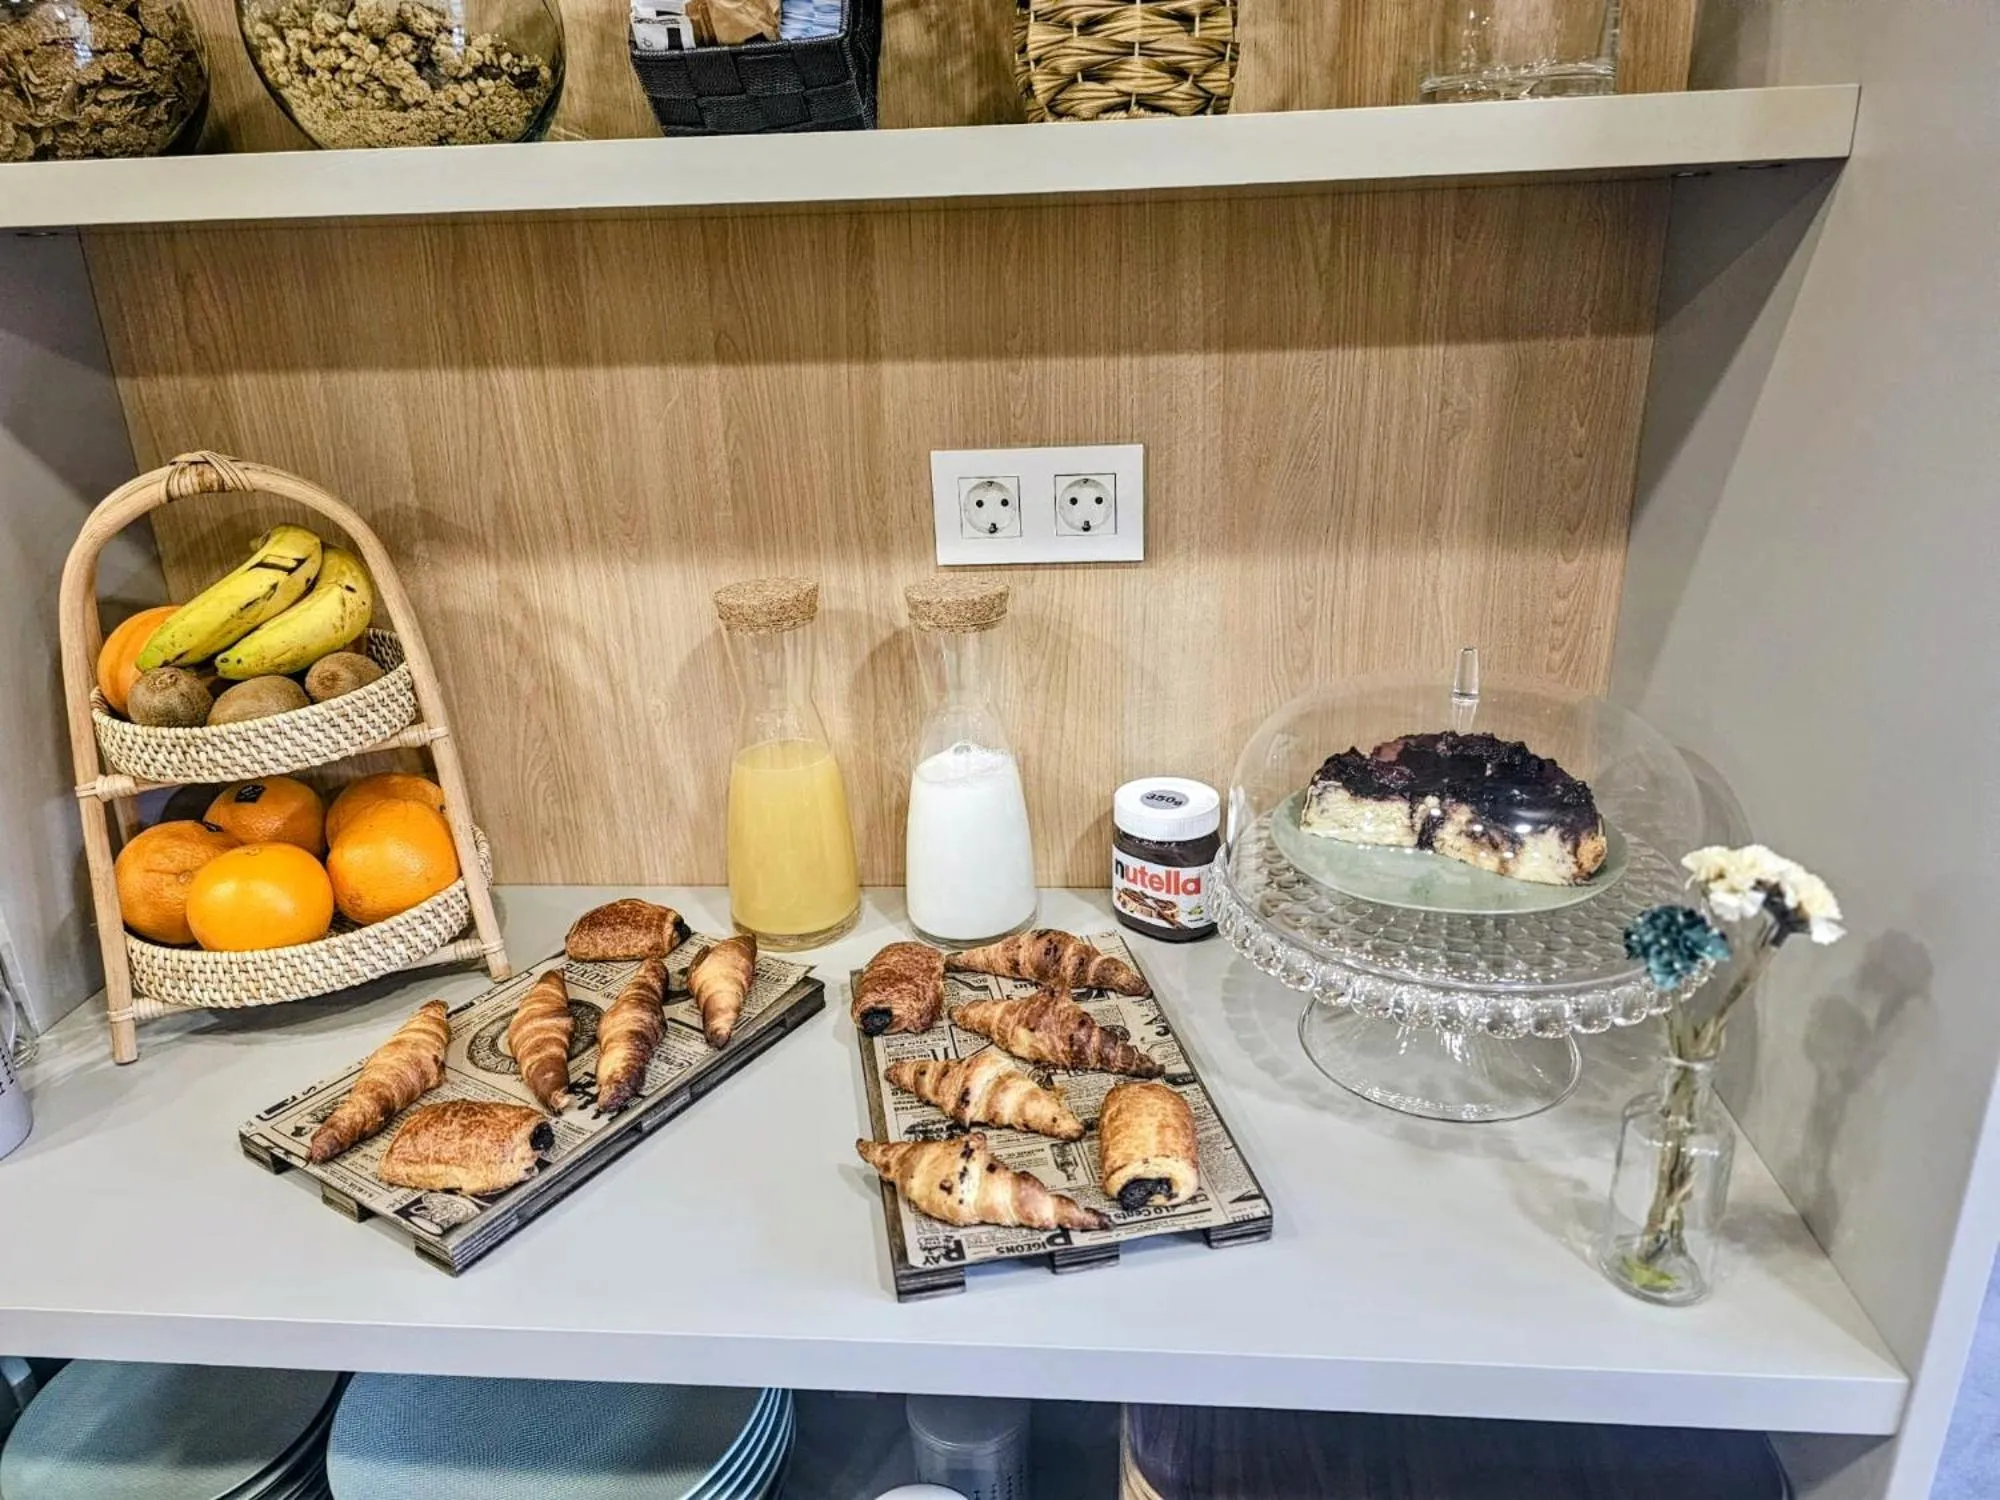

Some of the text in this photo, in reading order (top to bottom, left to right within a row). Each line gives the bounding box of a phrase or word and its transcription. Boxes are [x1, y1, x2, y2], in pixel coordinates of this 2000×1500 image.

[1145, 792, 1184, 807] 350g
[1114, 857, 1203, 896] nutella
[995, 1227, 1073, 1255] PIGEONS
